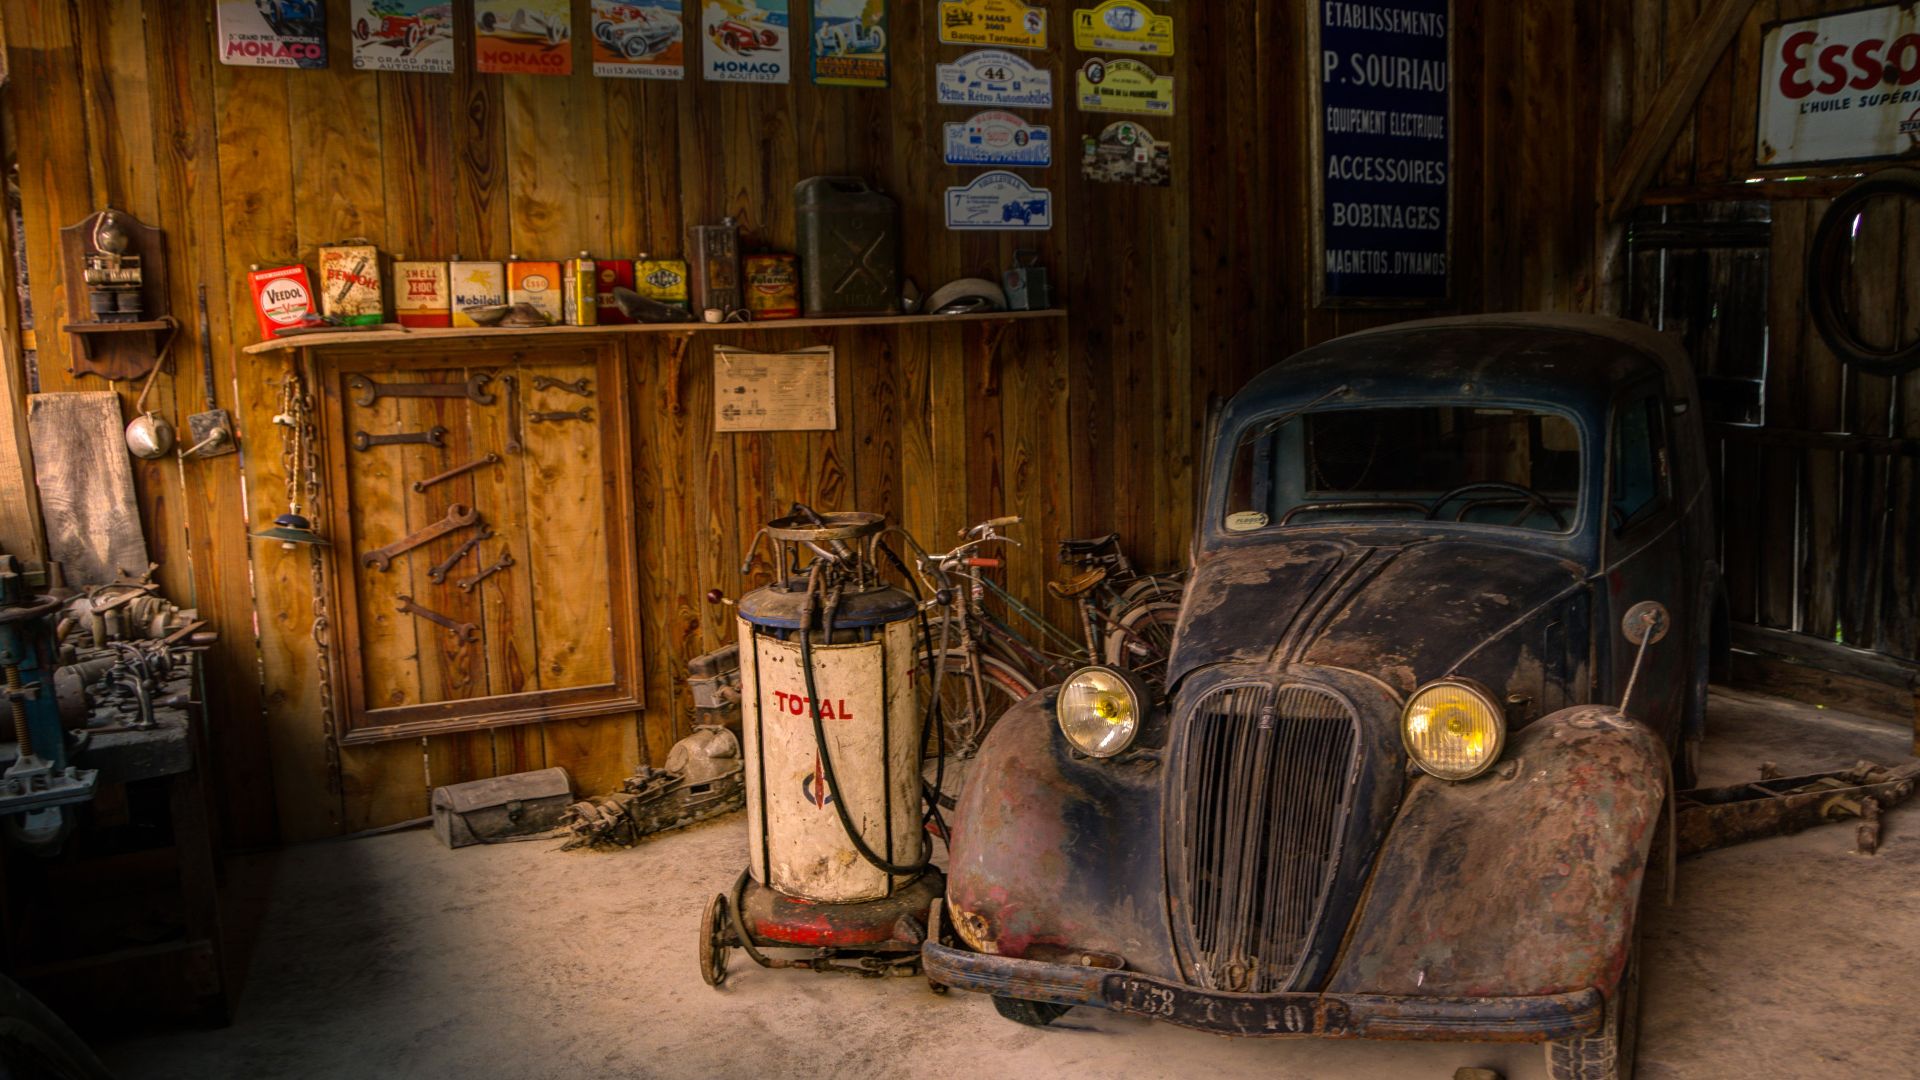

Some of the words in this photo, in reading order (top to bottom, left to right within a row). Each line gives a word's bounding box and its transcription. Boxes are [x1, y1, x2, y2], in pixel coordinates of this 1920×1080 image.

[985, 15, 1012, 23] MARS
[951, 31, 986, 42] Banque
[989, 33, 1030, 44] Tarneaud
[227, 41, 321, 59] MONACO
[483, 51, 566, 67] MONACO
[379, 64, 454, 72] AUTOMOBILE
[713, 61, 780, 73] MONACO
[984, 67, 1005, 80] 44
[968, 89, 993, 102] Rétro
[995, 89, 1051, 104] Automobiles
[1800, 97, 1850, 114] L'HUILE
[1328, 155, 1446, 185] ACCESSOIRES
[1332, 203, 1441, 230] BOBINAGES
[405, 270, 437, 279] SHELL
[456, 295, 501, 306] Mobiloil
[774, 690, 853, 720] TOTAL
